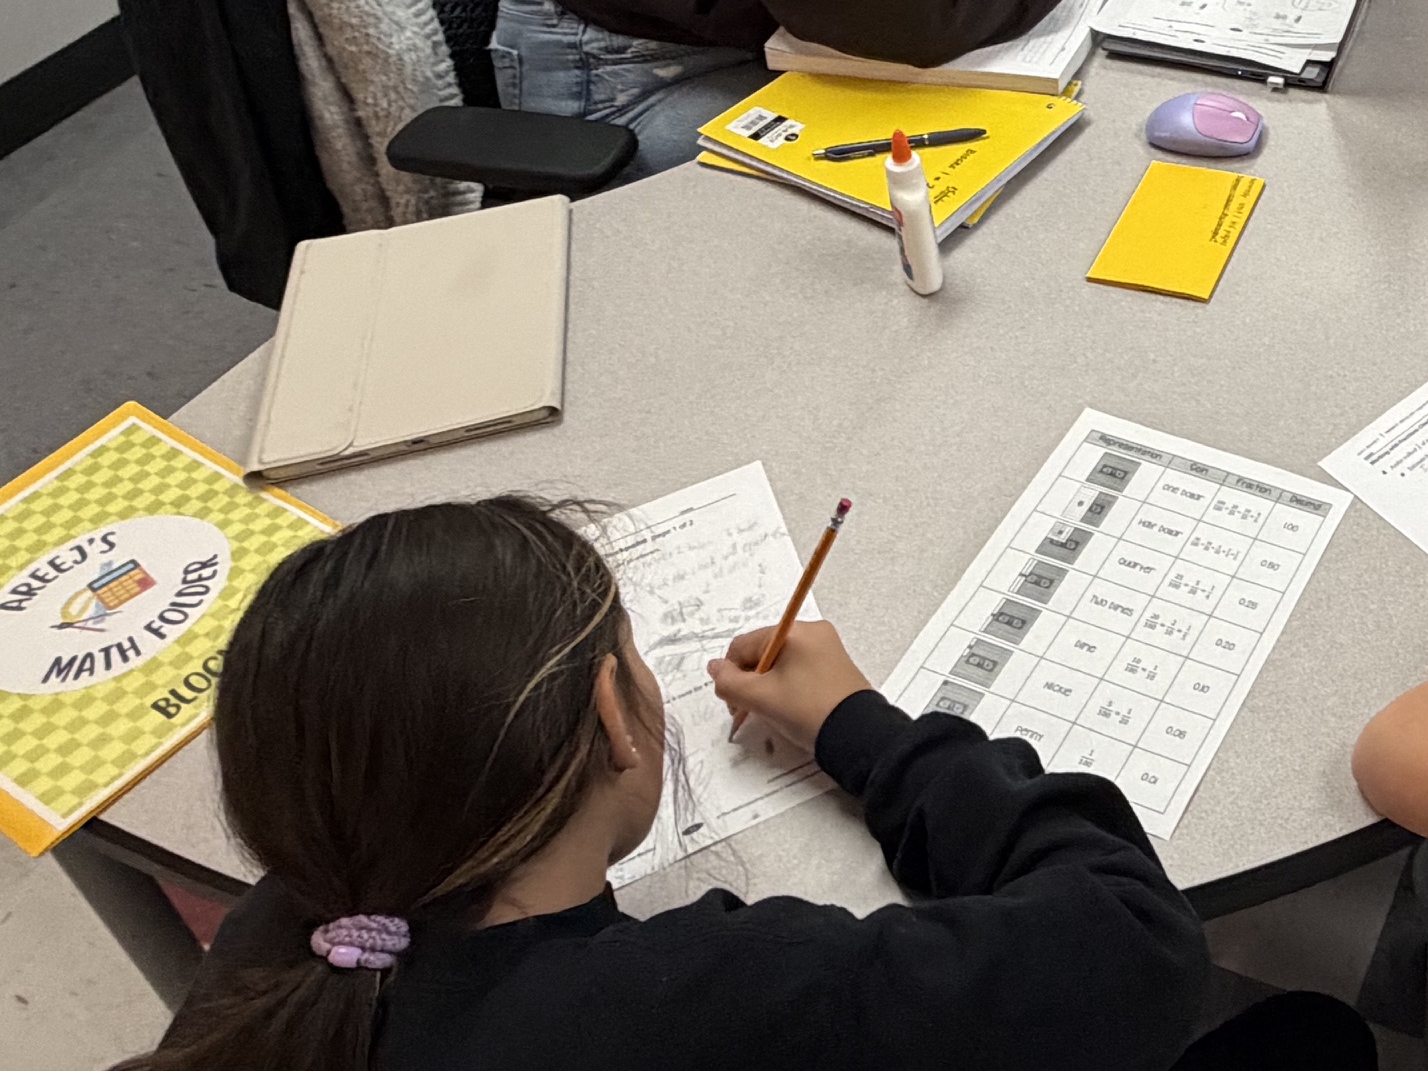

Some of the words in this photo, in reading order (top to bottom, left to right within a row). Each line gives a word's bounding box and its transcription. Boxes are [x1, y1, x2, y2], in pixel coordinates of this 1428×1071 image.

[1099, 434, 1163, 460] Representation
[1189, 462, 1209, 476] Coin
[1235, 478, 1272, 496] Fraction
[1, 531, 118, 613] AREEJ'S
[41, 634, 142, 685] MATH
[143, 553, 220, 641] FOLDER
[150, 647, 230, 722] BLOC
